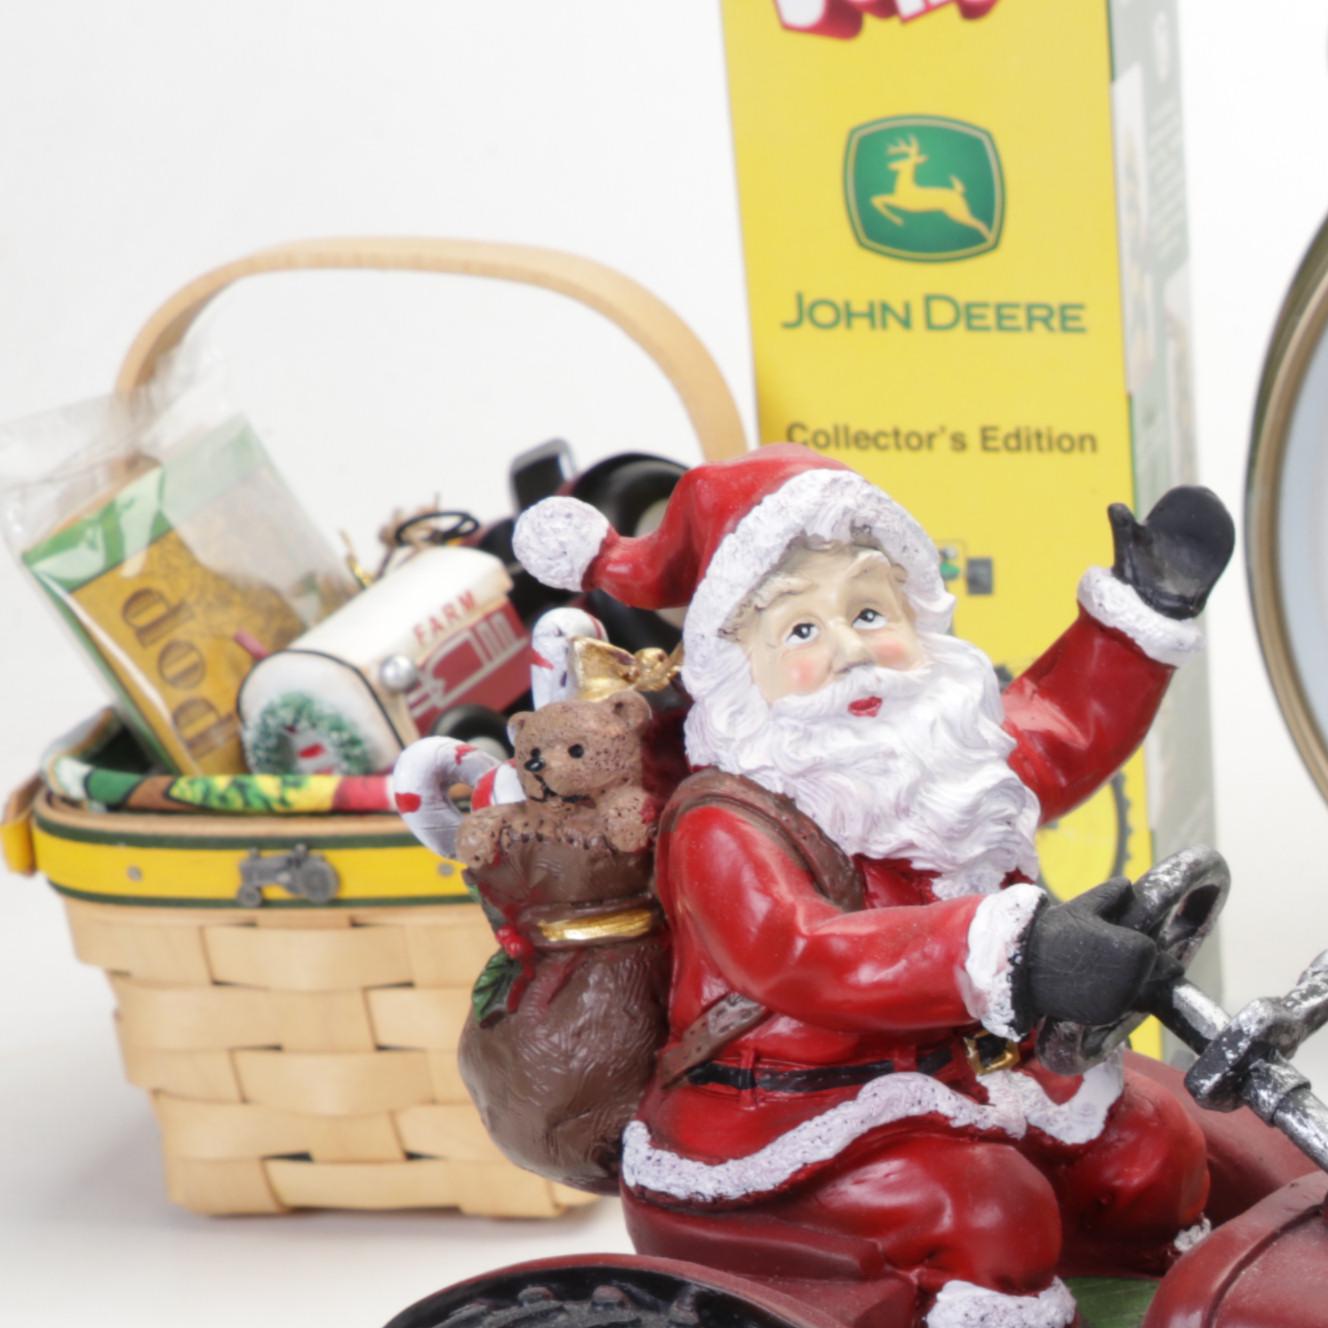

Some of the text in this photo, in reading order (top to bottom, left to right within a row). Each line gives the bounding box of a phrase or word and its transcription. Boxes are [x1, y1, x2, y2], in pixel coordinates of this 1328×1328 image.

[781, 291, 1088, 334] JOHN DEERE
[784, 421, 1098, 455] Collector's Edition
[412, 588, 476, 645] FARM
